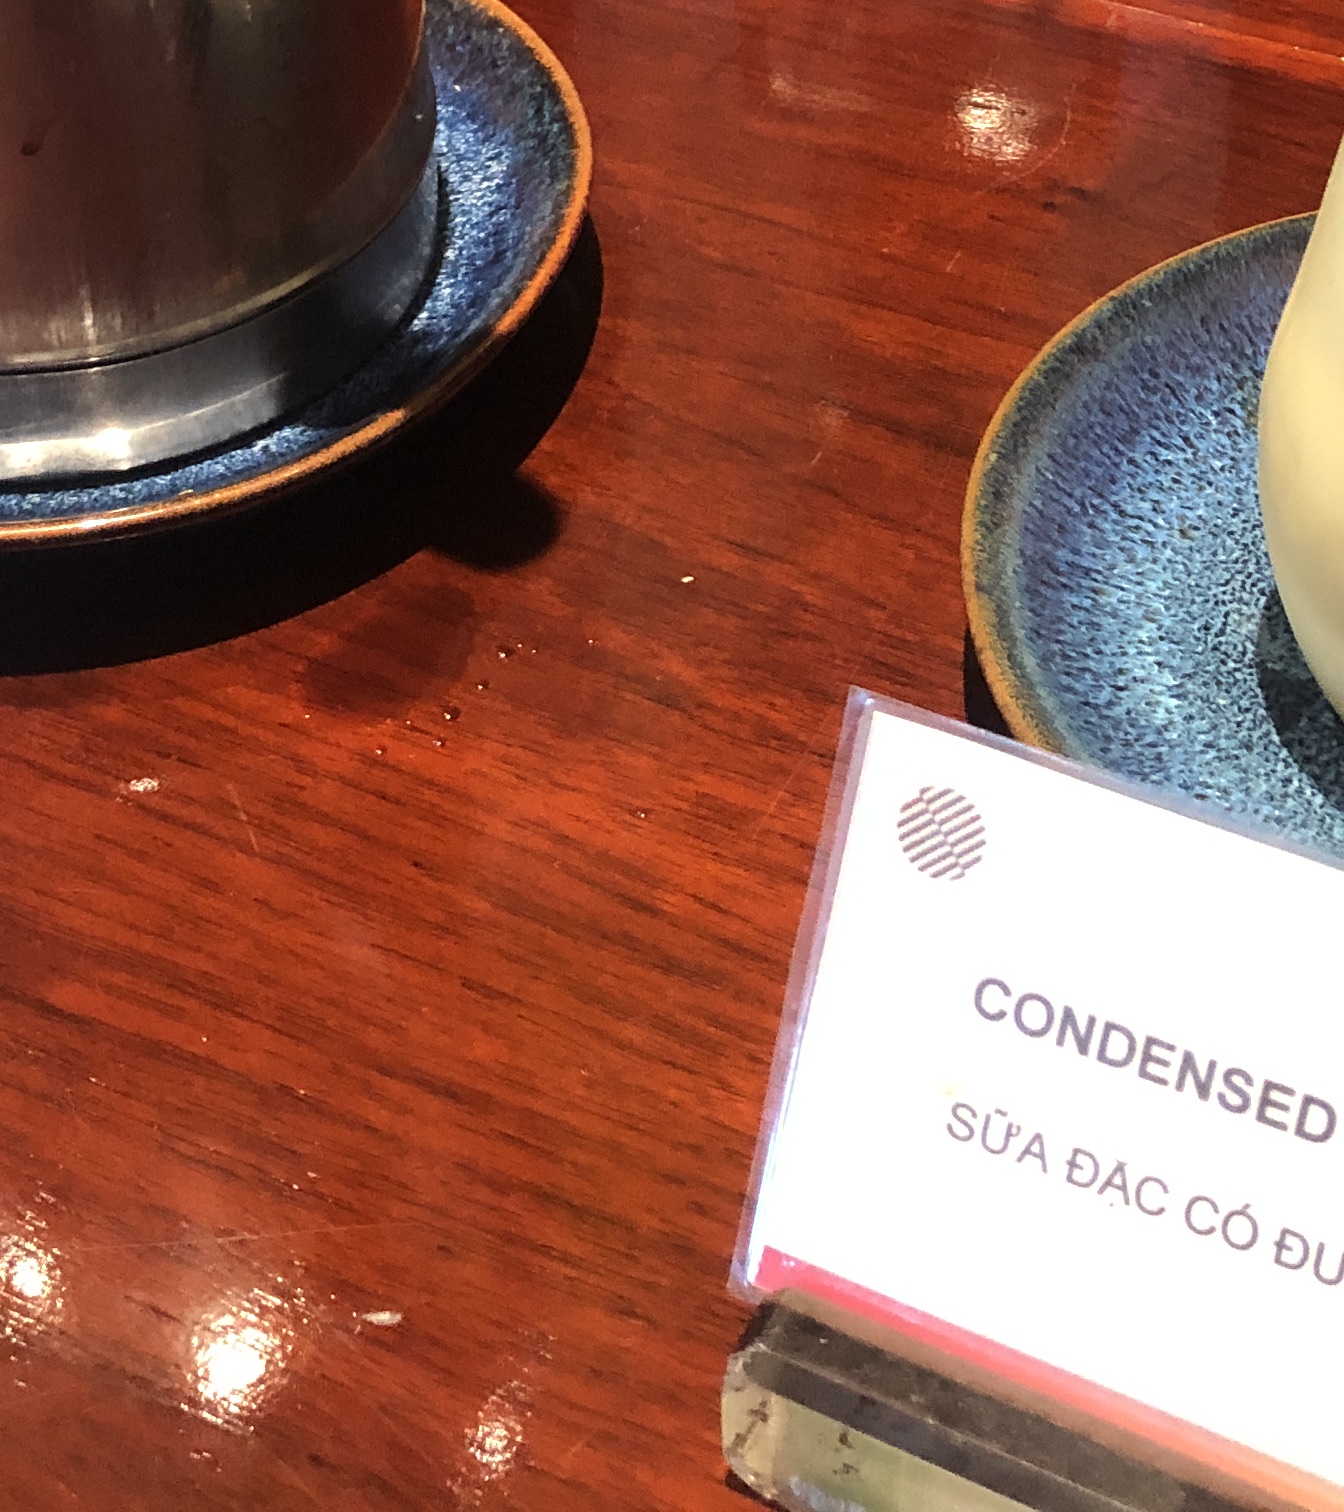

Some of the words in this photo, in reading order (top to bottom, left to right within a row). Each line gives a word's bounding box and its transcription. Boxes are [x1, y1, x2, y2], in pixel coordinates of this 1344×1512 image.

[973, 977, 1338, 1144] CONDENSED
[946, 1102, 1049, 1174] SỮA
[1183, 1195, 1260, 1251] CÓ
